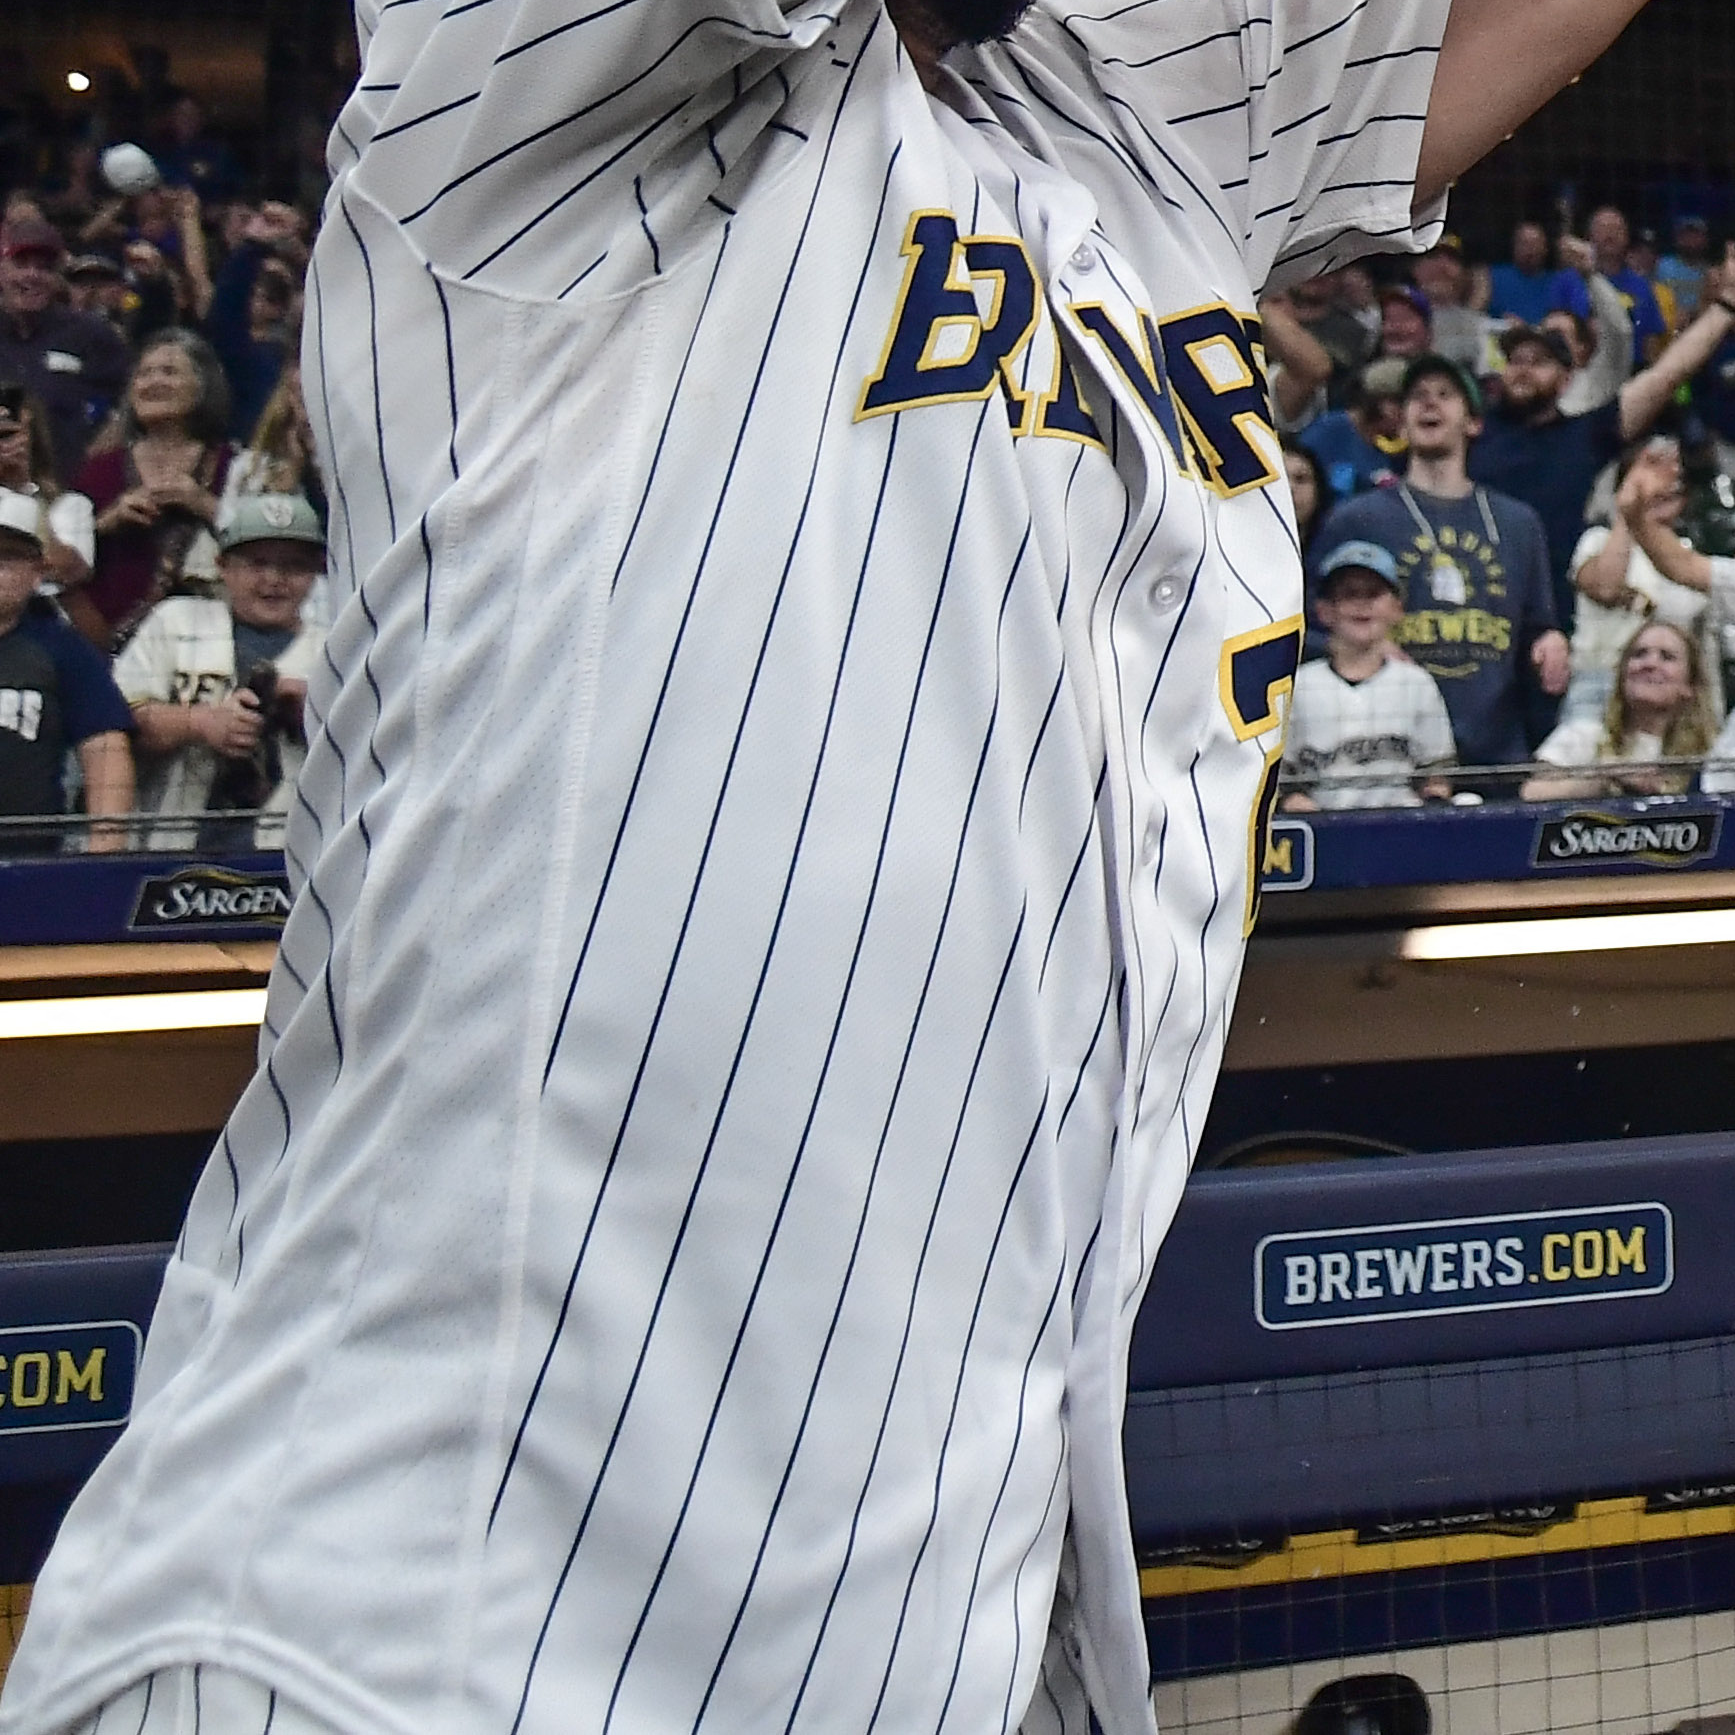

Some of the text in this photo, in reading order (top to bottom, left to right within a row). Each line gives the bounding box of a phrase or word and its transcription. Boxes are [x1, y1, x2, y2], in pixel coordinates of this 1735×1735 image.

[1550, 820, 1699, 858] SARGENTO
[156, 881, 291, 919] SARGEN
[1283, 1225, 1647, 1306] BREWERS.COM
